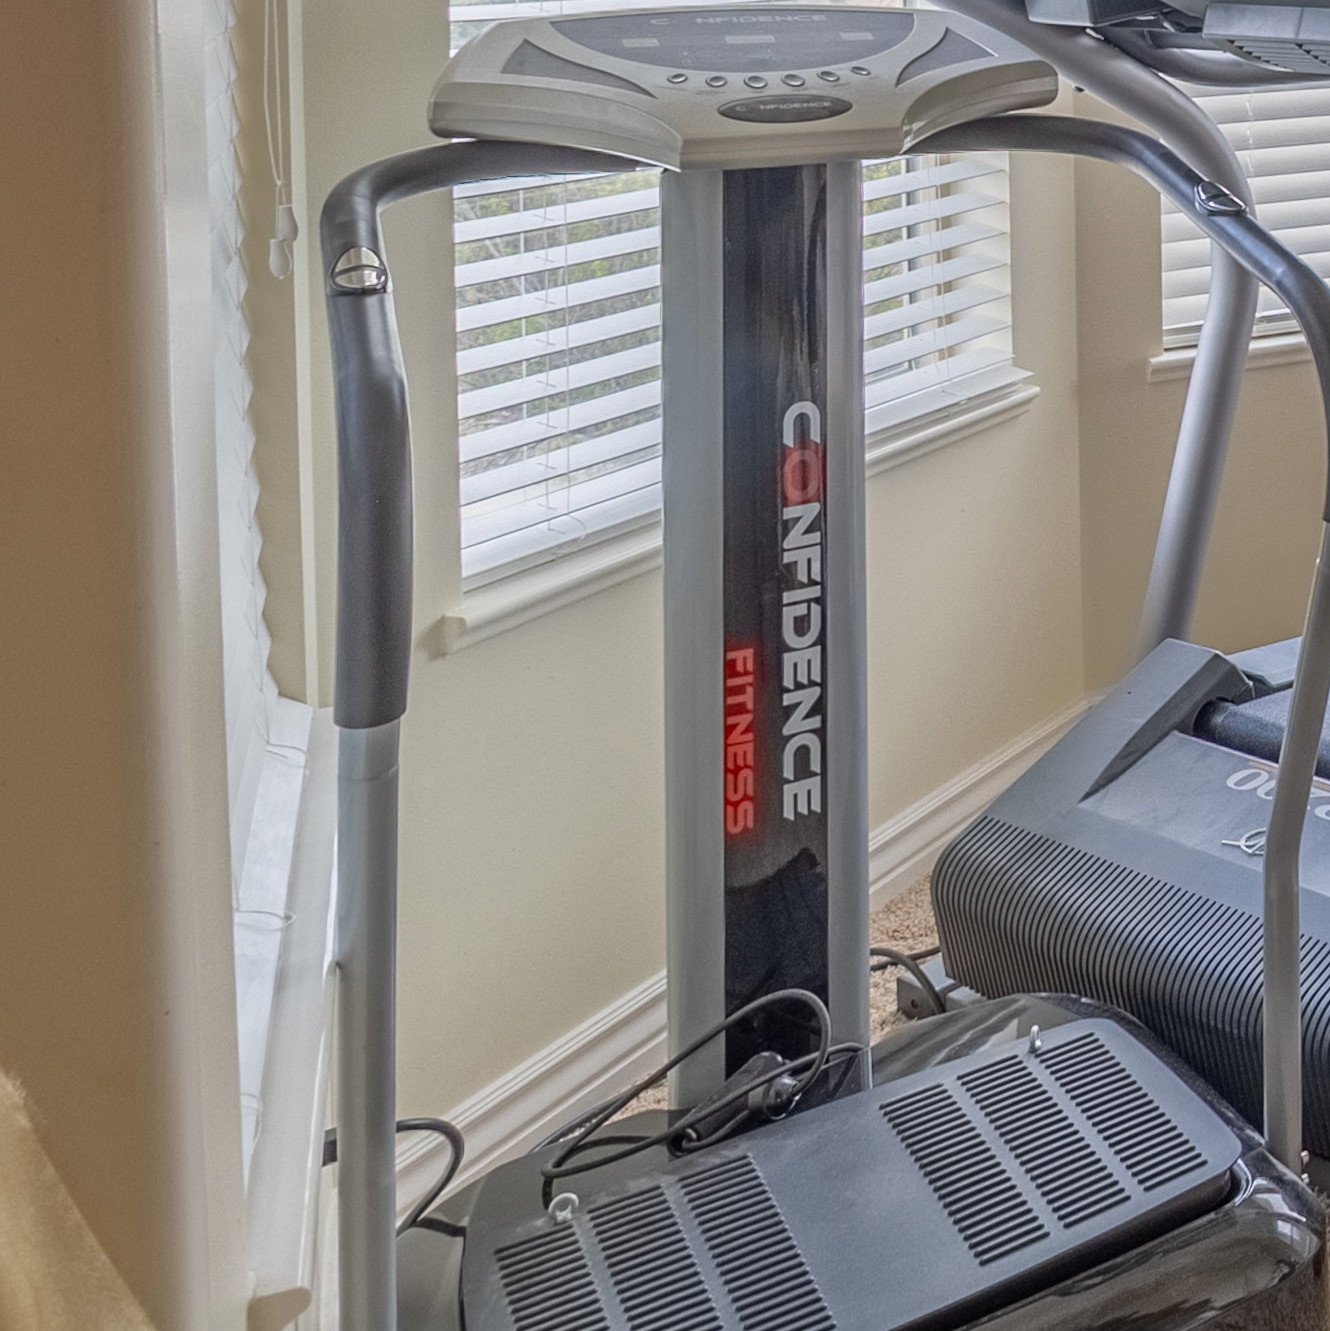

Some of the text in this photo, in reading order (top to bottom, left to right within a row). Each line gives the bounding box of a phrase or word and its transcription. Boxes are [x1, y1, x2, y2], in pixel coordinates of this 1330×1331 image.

[650, 14, 828, 25] CNFIDENCE
[734, 101, 833, 112] CNFIDENCE
[782, 401, 822, 821] CONFIDENCE
[726, 648, 755, 835] FITNESS
